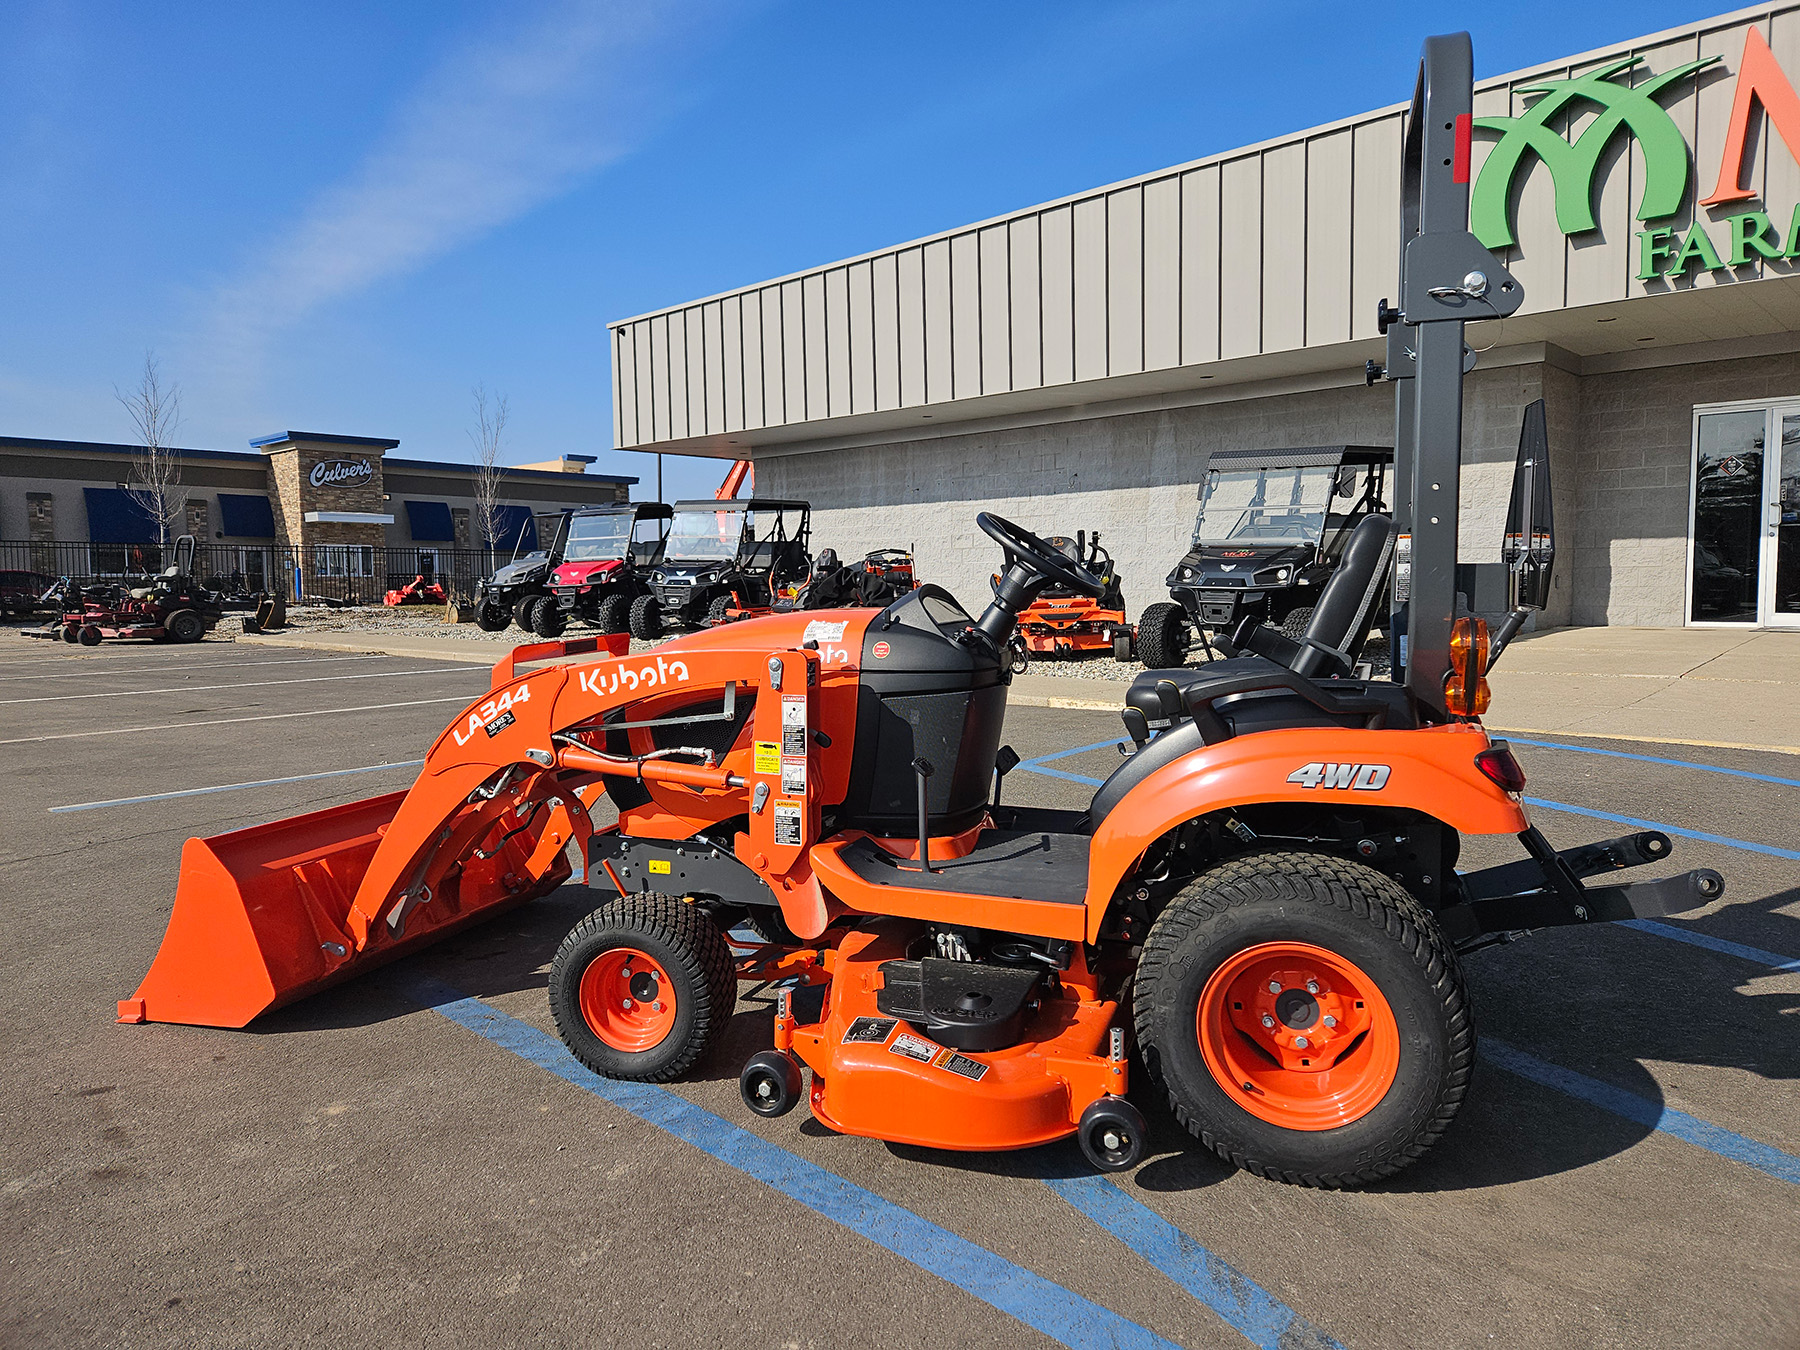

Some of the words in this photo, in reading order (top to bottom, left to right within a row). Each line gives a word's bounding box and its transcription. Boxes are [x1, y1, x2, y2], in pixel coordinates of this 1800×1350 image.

[1635, 203, 1800, 280] FAR
[309, 458, 373, 487] Culver's
[579, 656, 689, 697] Kubota
[452, 684, 531, 746] LA344
[1286, 762, 1392, 791] 4WD
